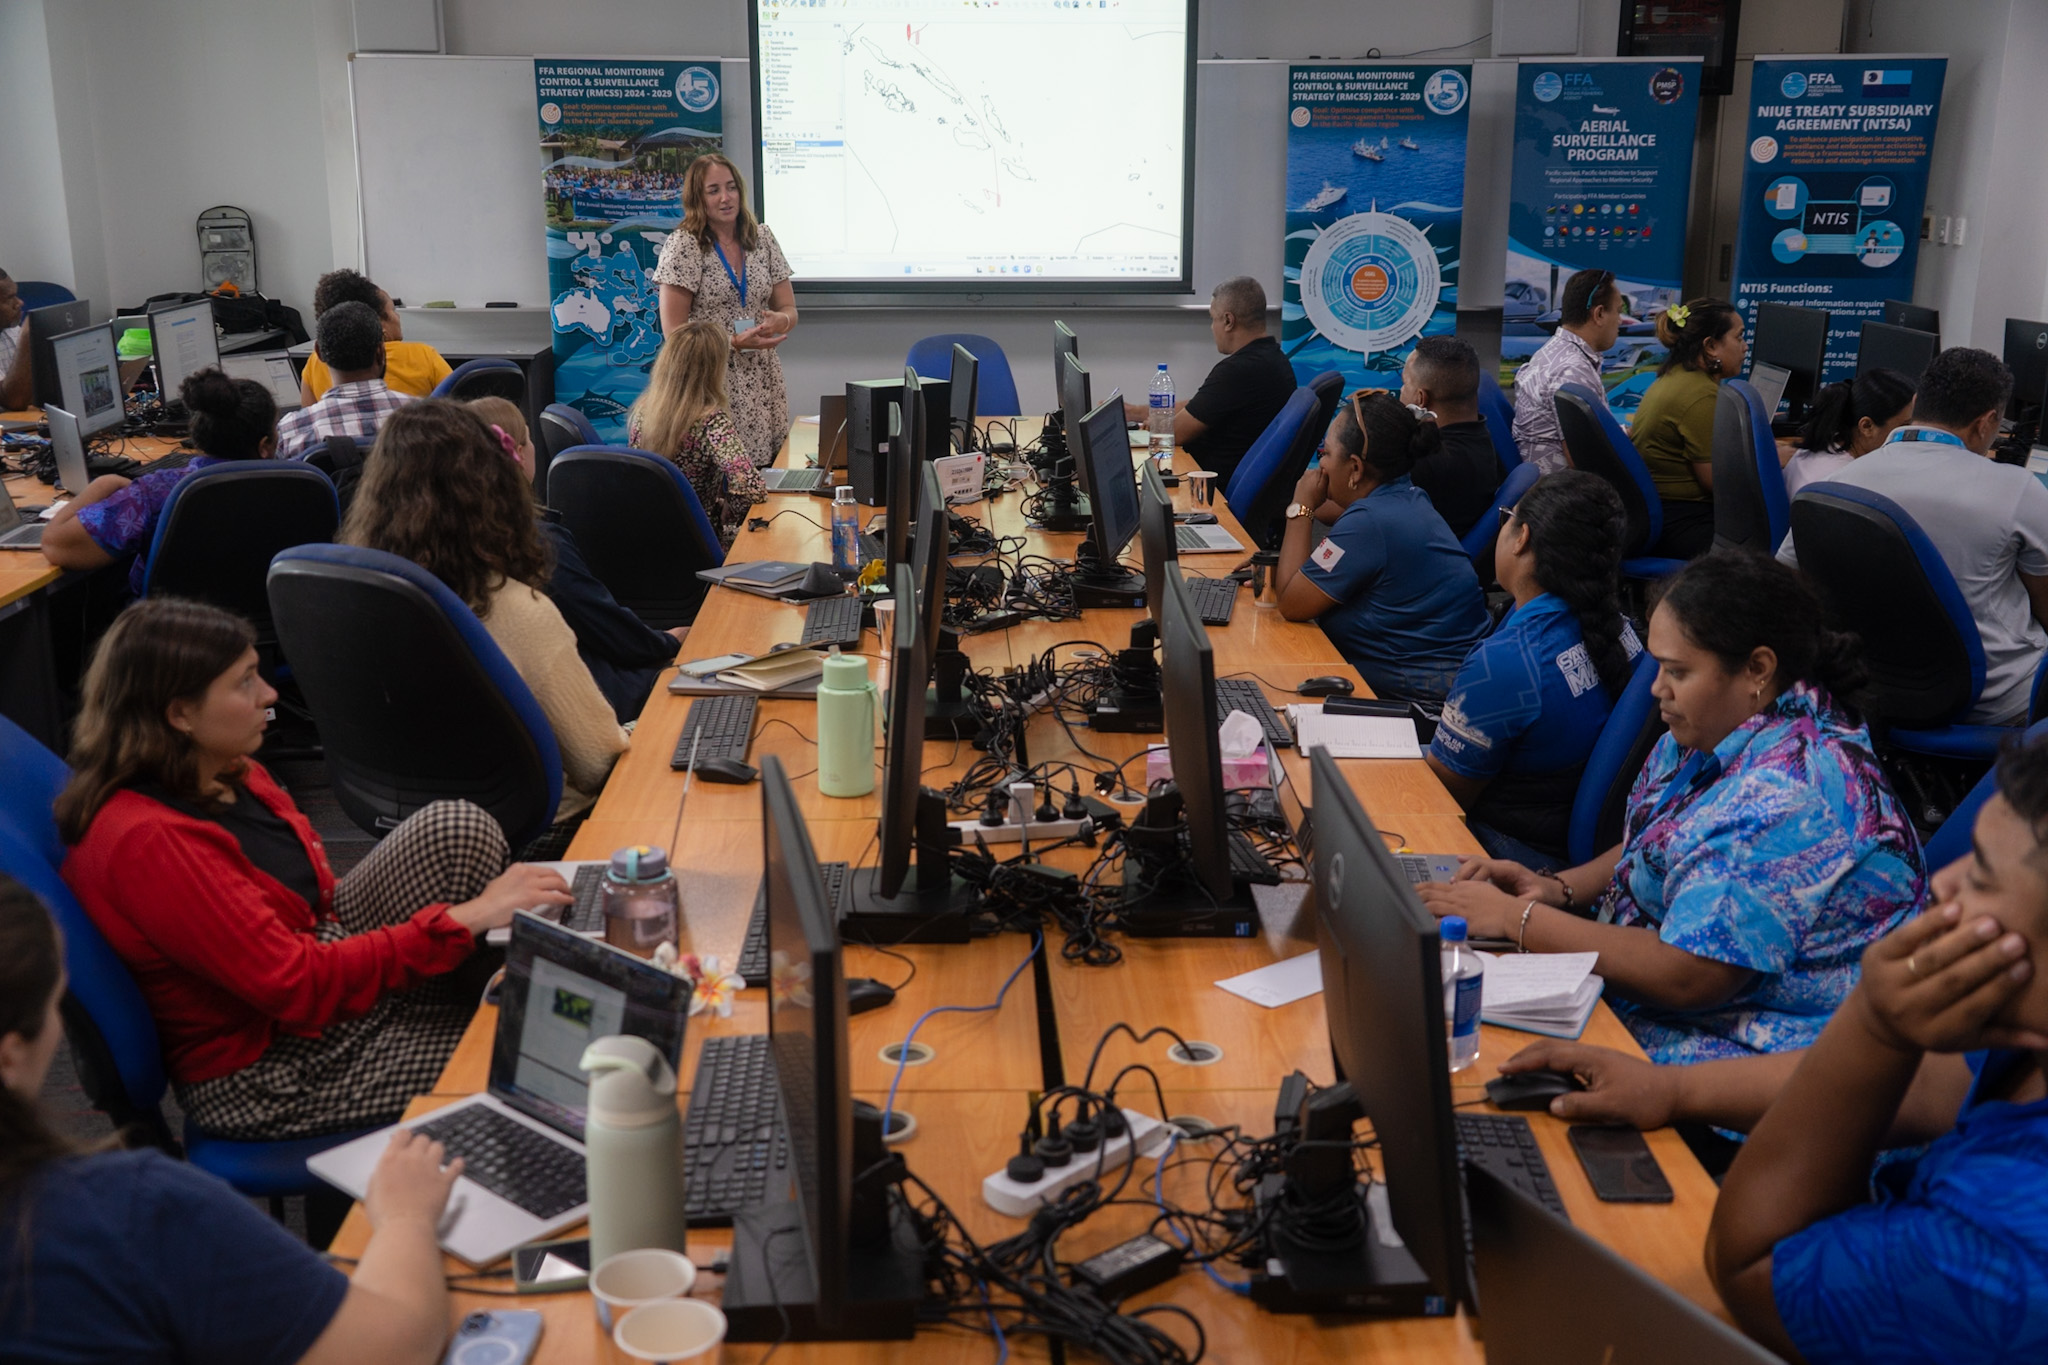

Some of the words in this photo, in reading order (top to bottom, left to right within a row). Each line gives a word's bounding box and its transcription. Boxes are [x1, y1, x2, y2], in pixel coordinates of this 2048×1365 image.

[539, 67, 555, 76] FFA
[557, 67, 602, 76] REGIONAL
[604, 68, 665, 77] MONITORING
[1293, 72, 1308, 80] FFA
[1310, 72, 1354, 80] REGIONAL
[1356, 72, 1416, 80] MONITORING
[539, 78, 582, 86] CONTROL
[584, 78, 592, 86] &
[594, 78, 659, 87] SURVEILLANCE
[1564, 74, 1594, 86] FFA
[1808, 73, 1835, 84] FFA
[1293, 82, 1334, 90] CONTROL
[1336, 82, 1343, 90] &
[1344, 82, 1409, 90] SURVEILLANCE
[540, 88, 584, 97] STRATEGY
[586, 89, 623, 98] (RMCSS)
[624, 89, 646, 98] 2024
[652, 90, 672, 98] 2029
[1292, 92, 1334, 101] STRATEGY
[1336, 92, 1372, 102] (RMCSS)
[1373, 92, 1394, 101] 2024
[1400, 92, 1421, 101] 2029
[1757, 106, 1792, 117] NIUE
[1796, 105, 1846, 117] TREATY
[1849, 104, 1934, 116] SUBSIDIARY
[1580, 120, 1630, 132] AERIAL
[1776, 119, 1860, 131] AGREEMENT
[1863, 118, 1912, 132] (NTSA)
[1552, 134, 1656, 146] SURVEILLANCE
[1829, 136, 1874, 144] participation
[1567, 148, 1639, 161] PROGRAM
[1783, 150, 1815, 158] providing
[1840, 157, 1872, 165] exchange
[1813, 212, 1849, 225] NTIS
[1740, 283, 1768, 293] NTIS
[1770, 283, 1833, 293] Functions:
[1835, 330, 1845, 338] by
